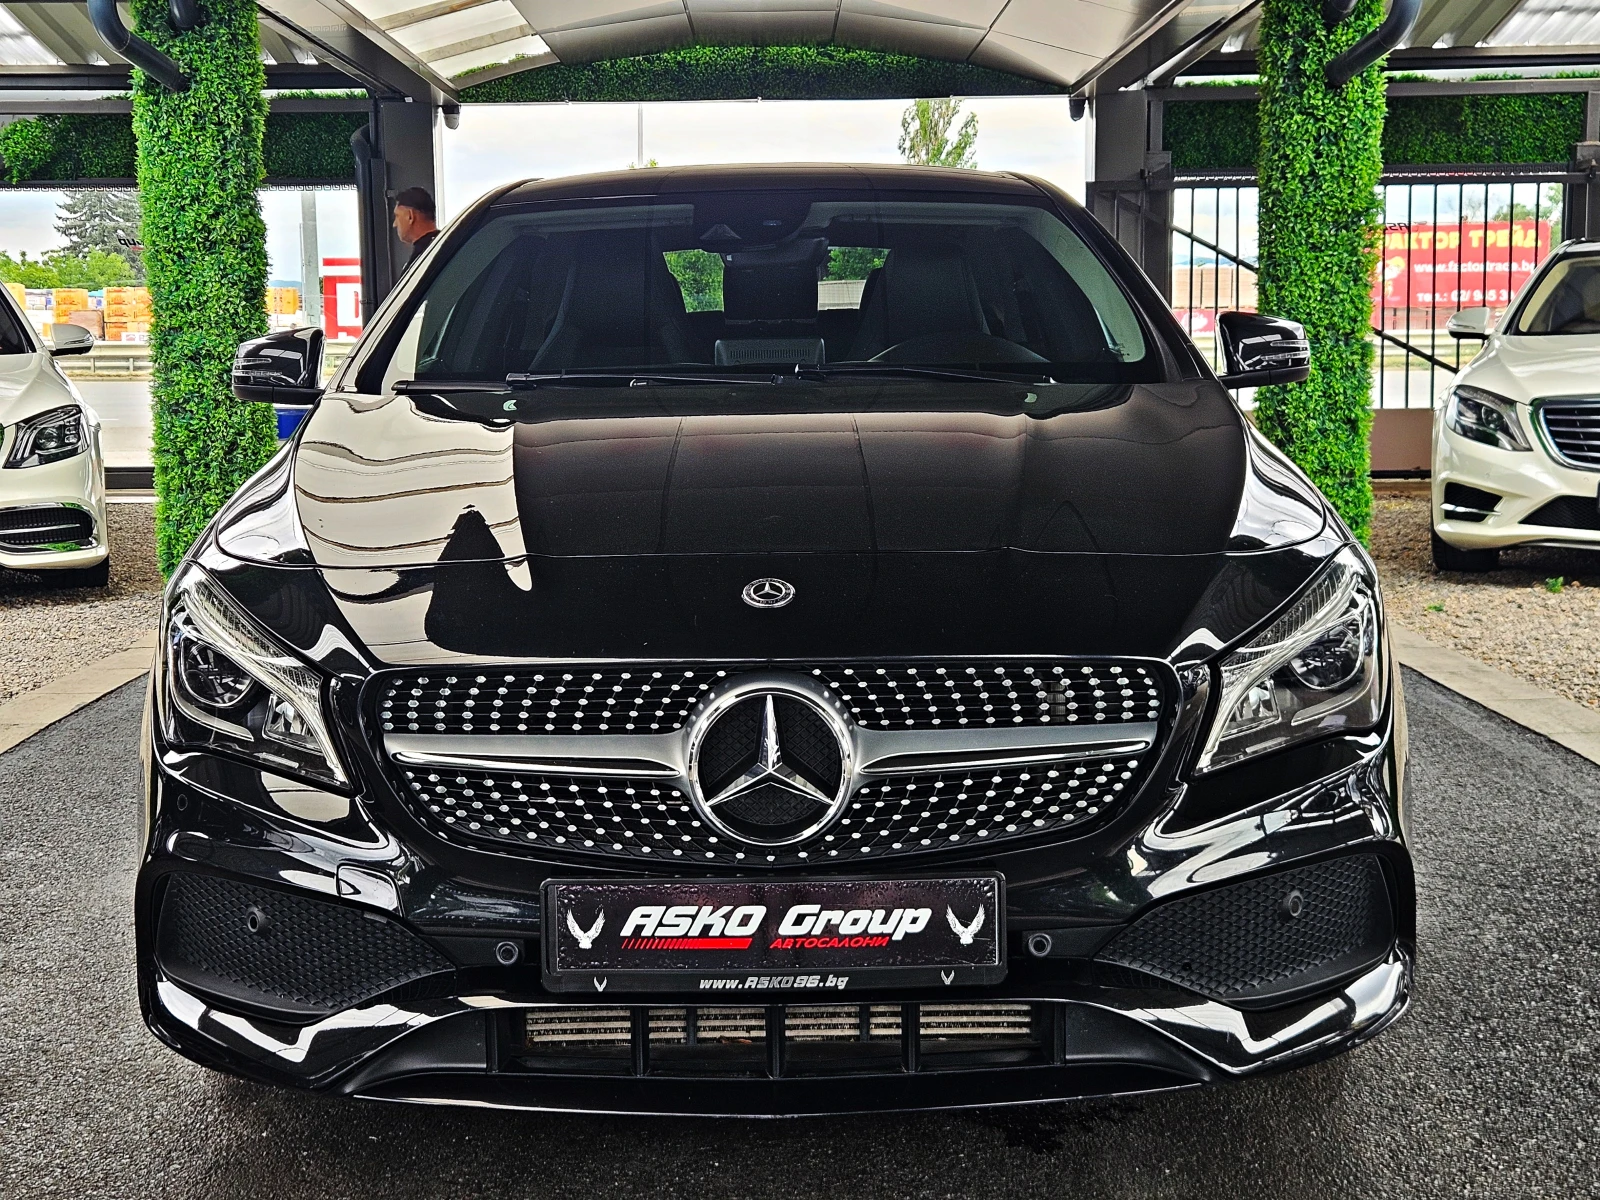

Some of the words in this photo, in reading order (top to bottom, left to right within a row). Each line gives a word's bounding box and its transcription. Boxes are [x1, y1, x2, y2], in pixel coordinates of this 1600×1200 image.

[1469, 225, 1542, 248] ТРЕЙД
[620, 905, 767, 937] ASKO
[778, 904, 932, 941] Group
[769, 936, 890, 949] АВТОСАЛОНИ
[699, 974, 850, 990] www.ASKO96.bg
